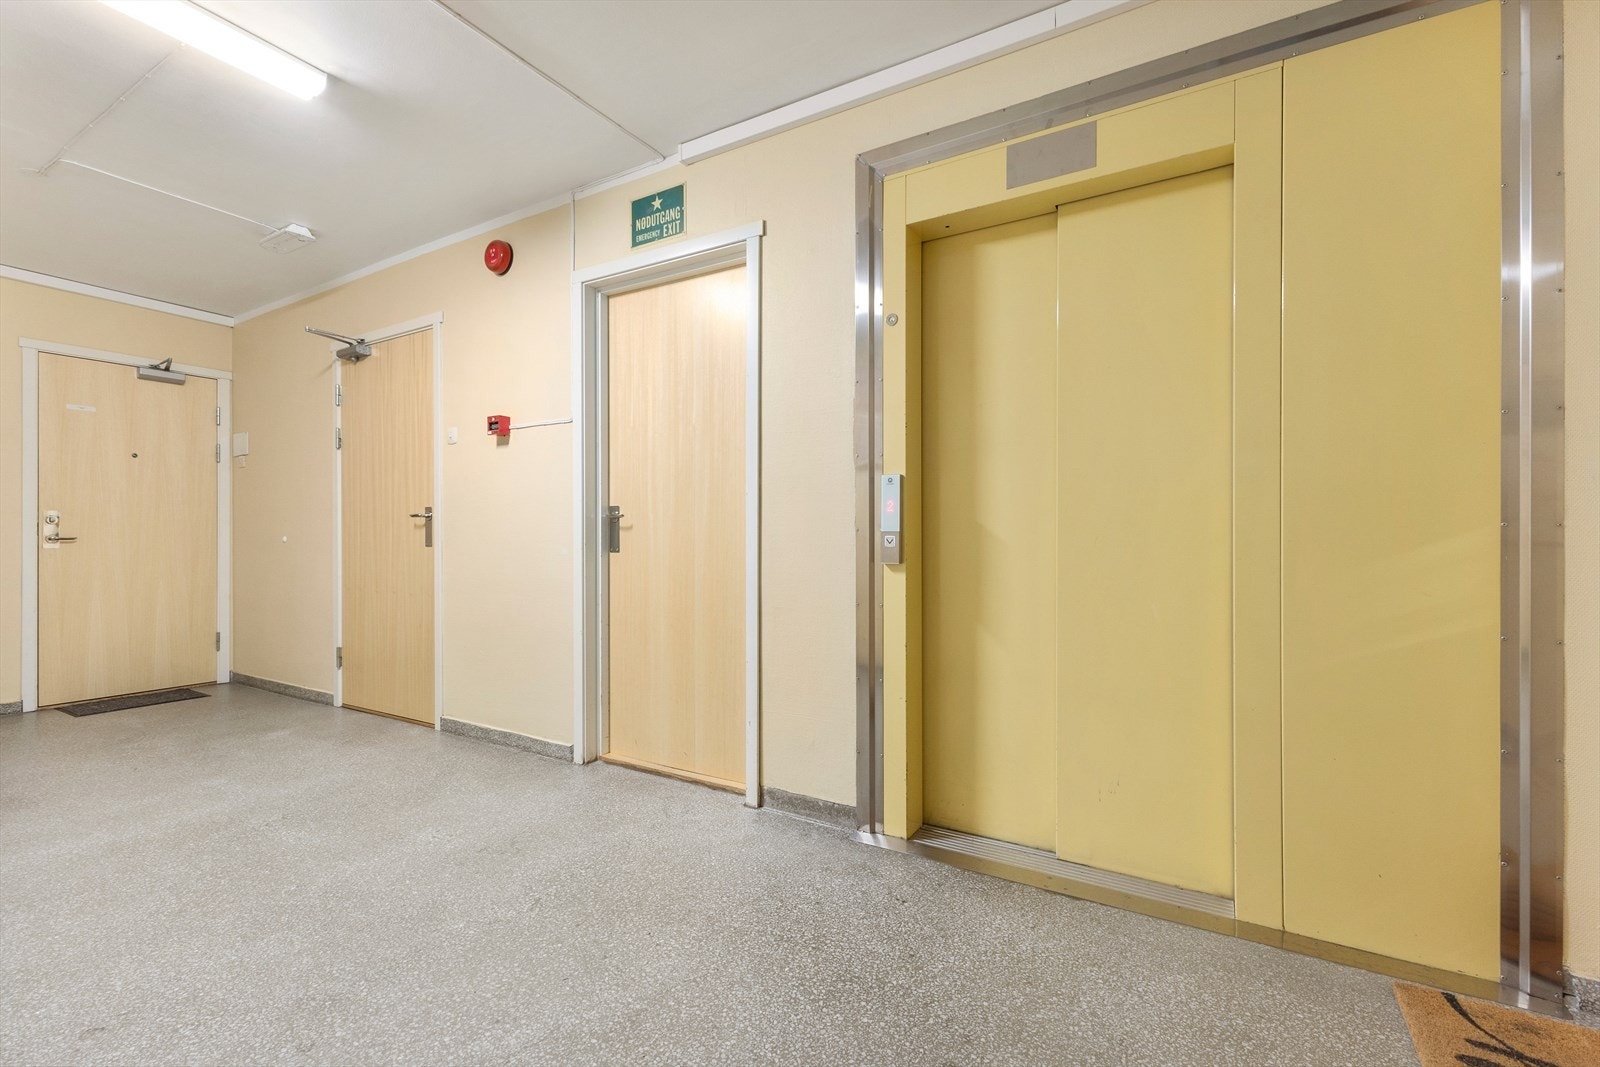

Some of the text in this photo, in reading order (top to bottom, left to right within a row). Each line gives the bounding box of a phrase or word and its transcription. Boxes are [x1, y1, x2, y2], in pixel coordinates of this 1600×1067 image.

[635, 206, 681, 231] NØDUTGANG
[635, 220, 681, 243] EMERGENCY EXIT
[886, 499, 895, 513] 2
